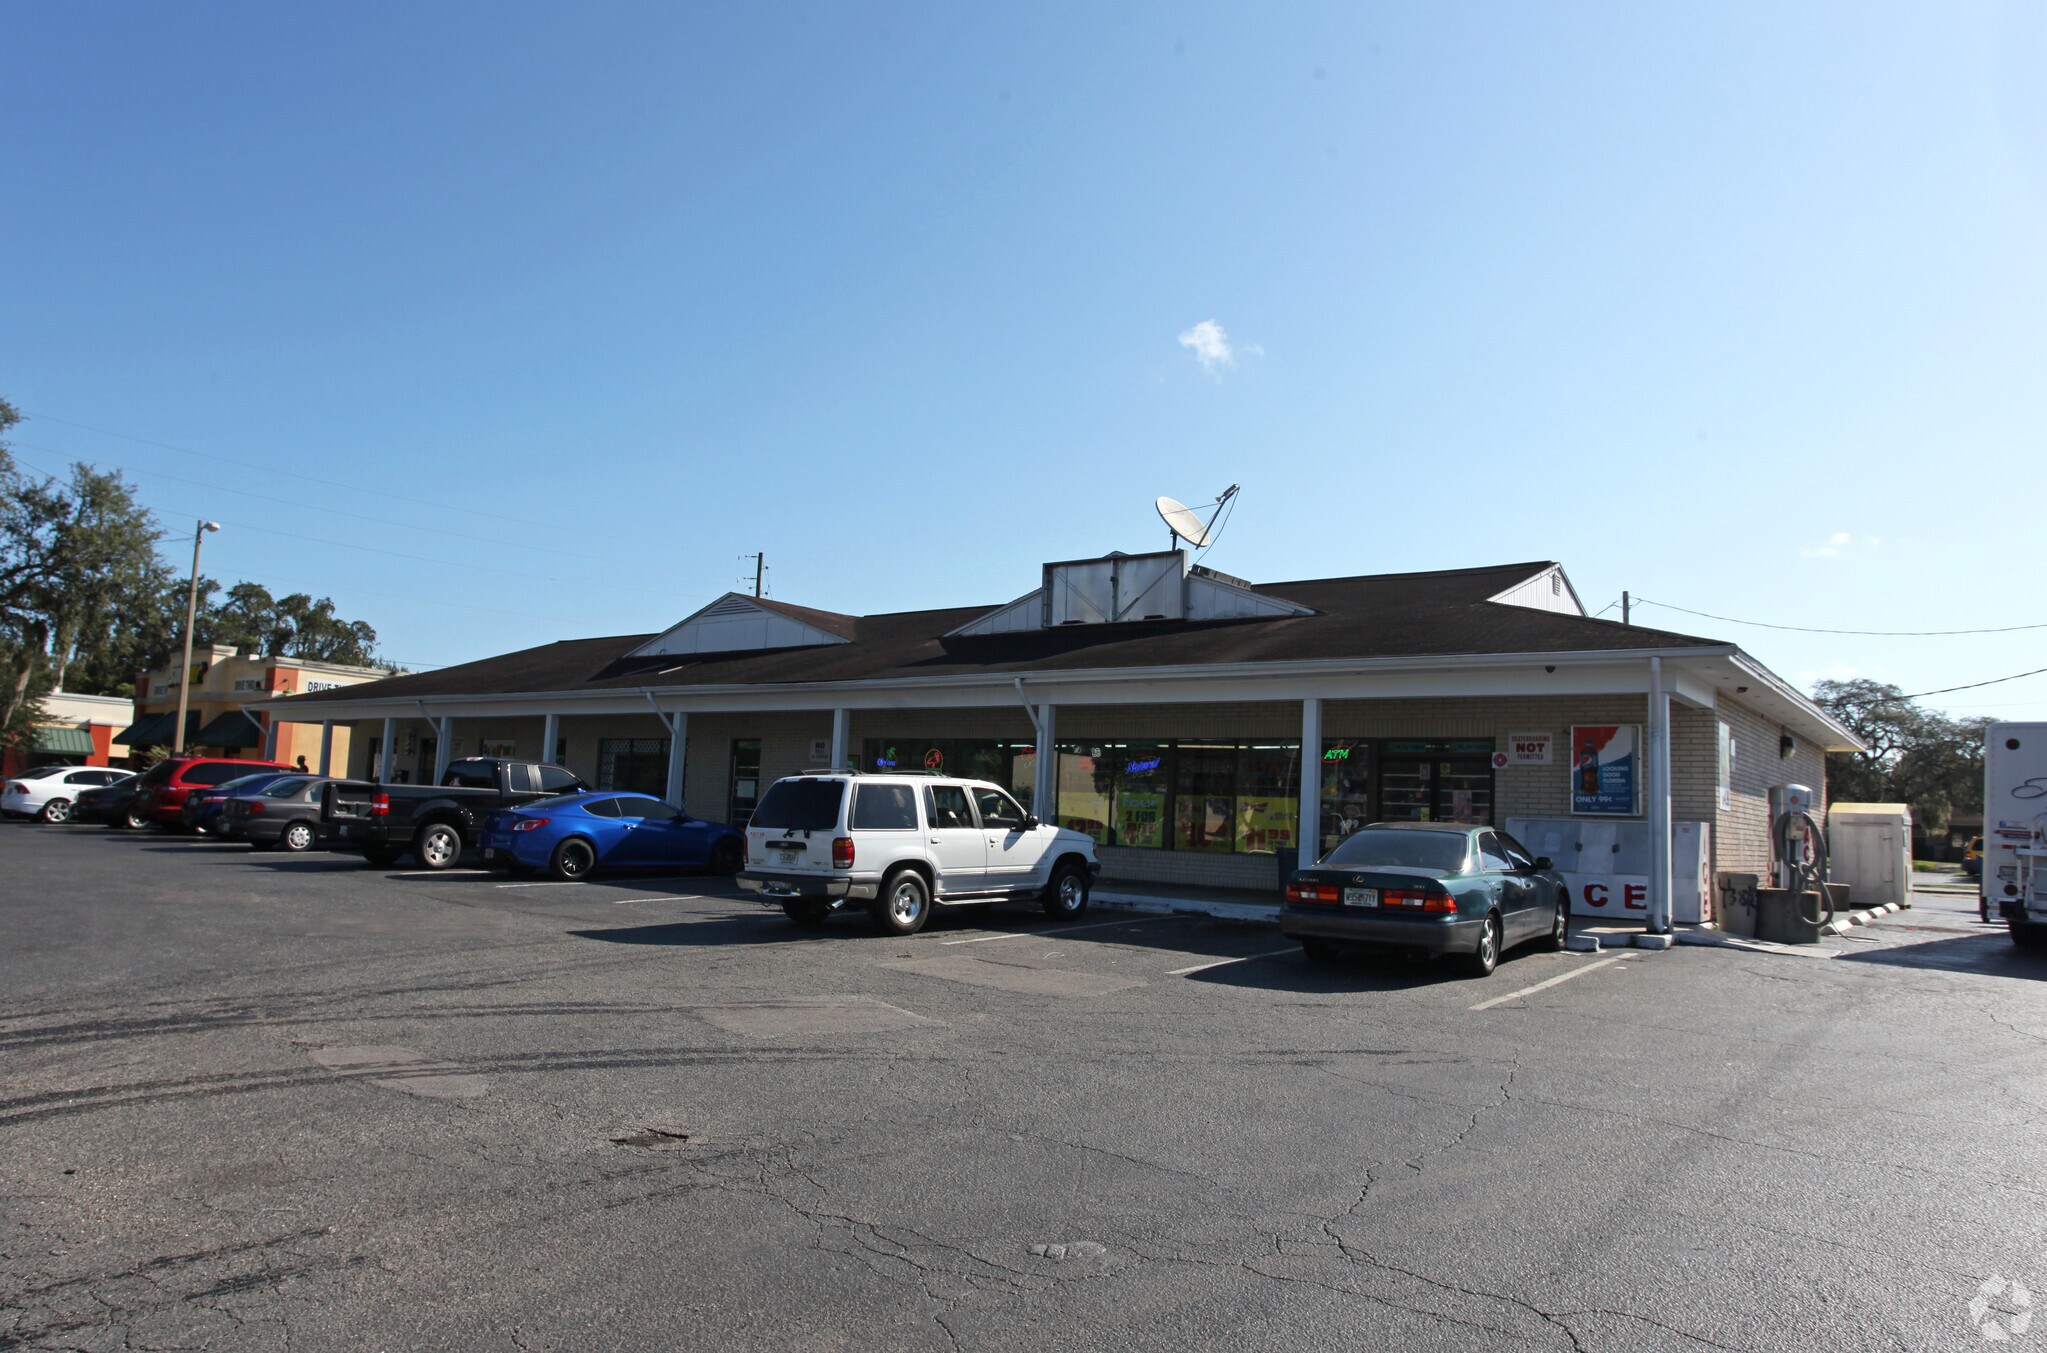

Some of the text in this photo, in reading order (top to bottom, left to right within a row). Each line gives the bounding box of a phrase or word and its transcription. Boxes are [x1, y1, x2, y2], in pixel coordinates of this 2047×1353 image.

[308, 681, 331, 692] DRIVE
[1516, 743, 1545, 752] NOT
[1324, 748, 1349, 760] ATM
[1135, 811, 1156, 822] FOR
[1583, 883, 1648, 910] CE
